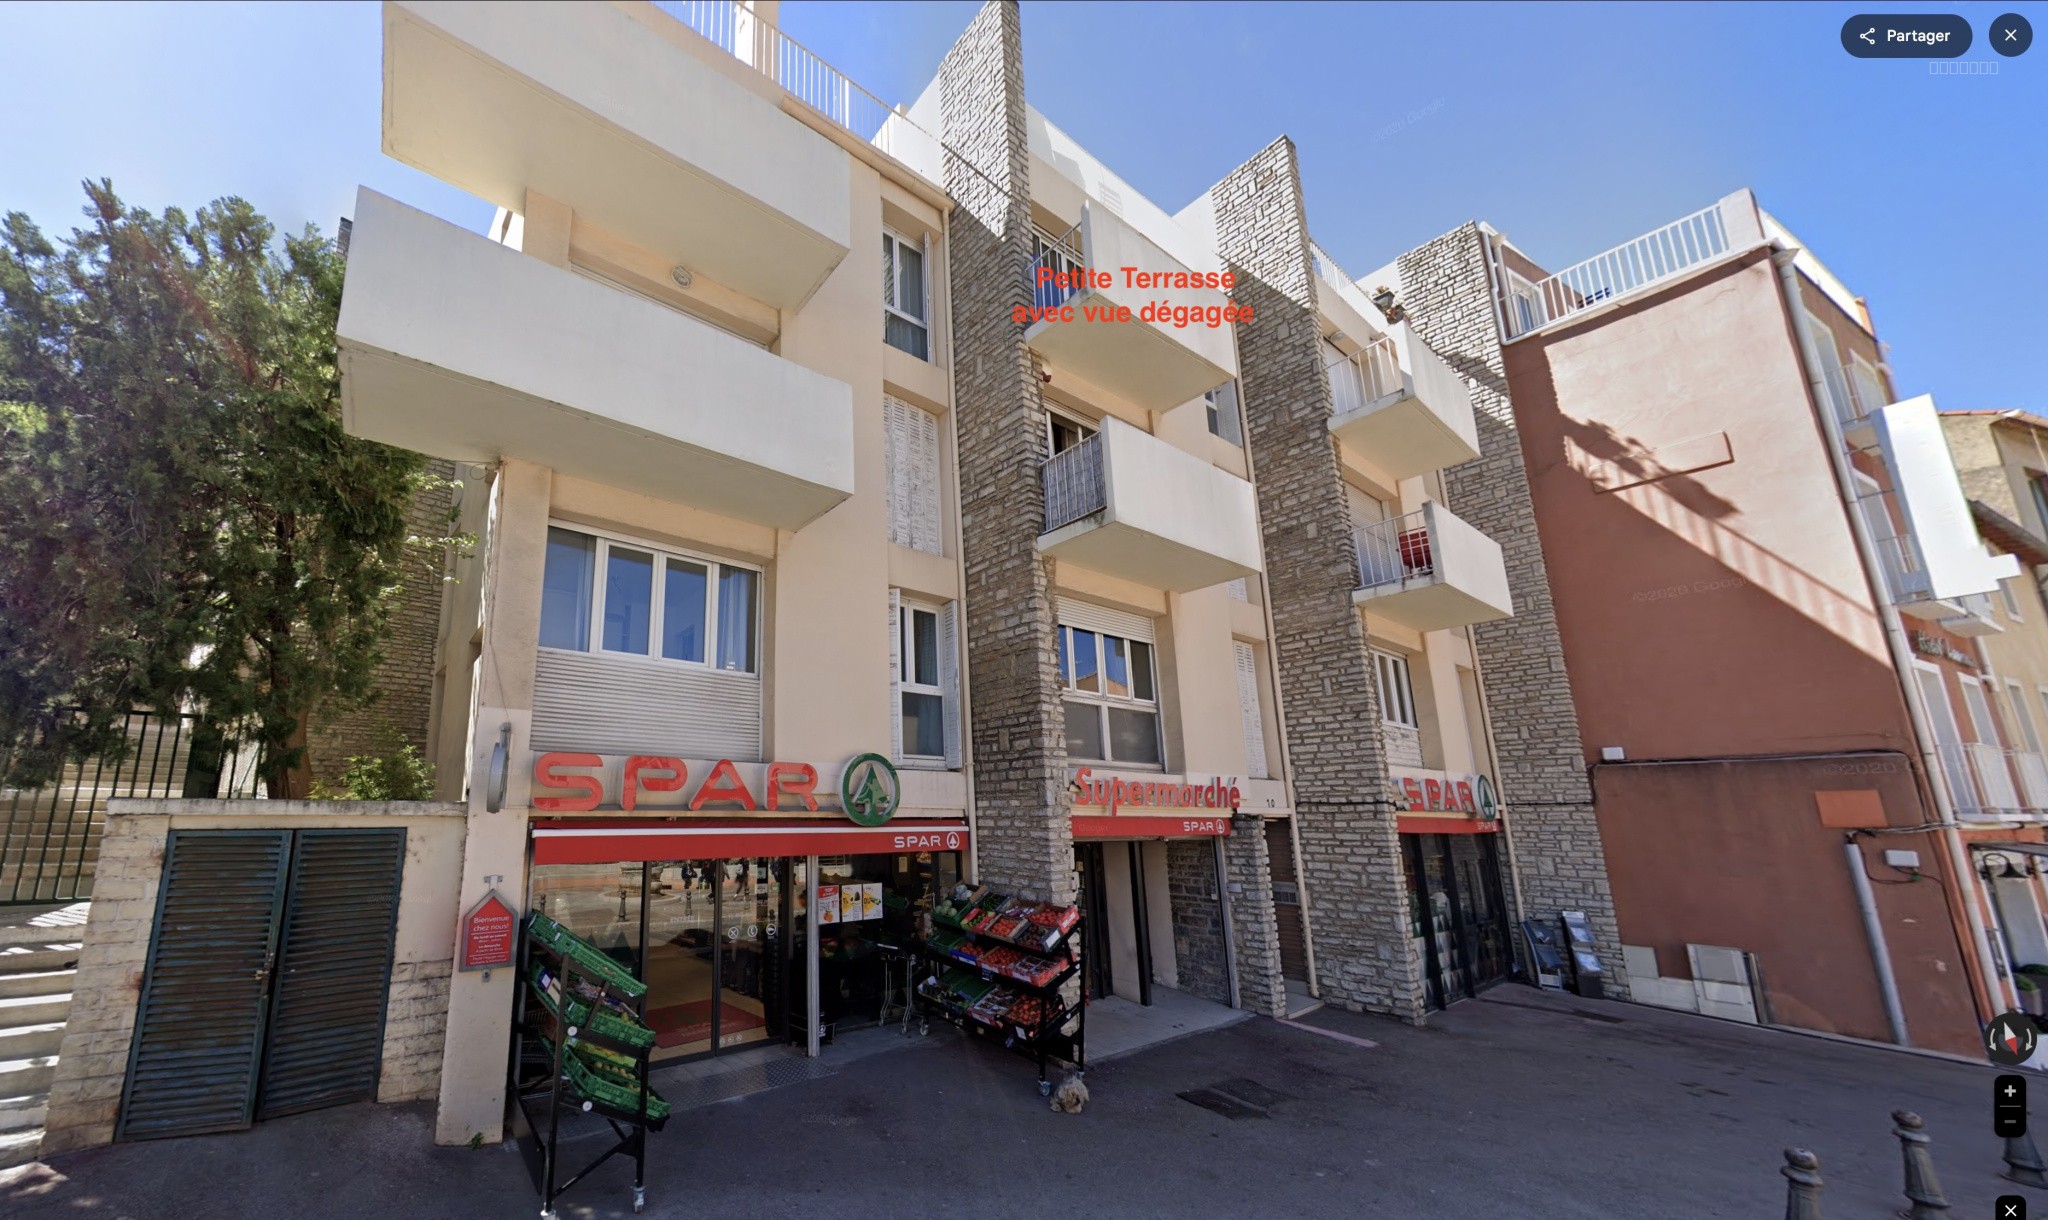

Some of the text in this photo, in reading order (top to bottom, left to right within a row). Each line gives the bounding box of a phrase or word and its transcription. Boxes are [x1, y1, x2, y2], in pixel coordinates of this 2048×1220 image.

[532, 751, 819, 812] SPAR
[1075, 766, 1241, 817] Supermarché
[1398, 776, 1476, 813] SPAR
[1183, 820, 1214, 833] SPAR
[893, 835, 942, 849] SPAR
[473, 916, 510, 924] Bienvenue
[473, 924, 490, 932] chez
